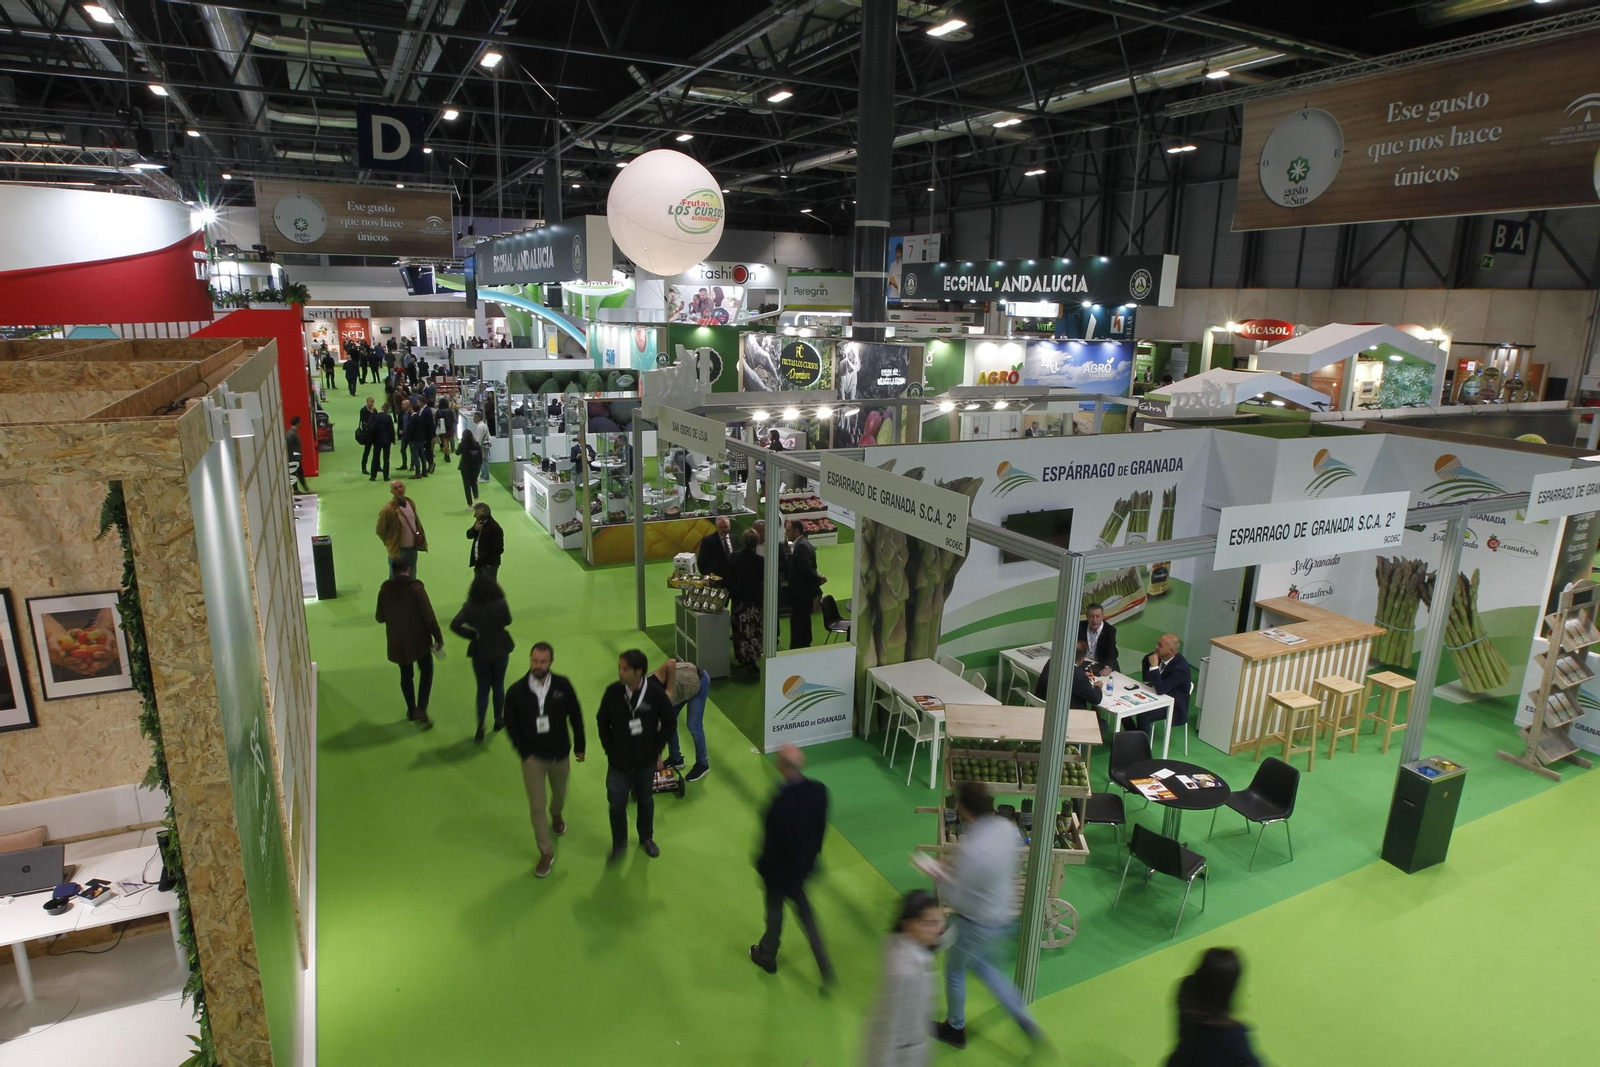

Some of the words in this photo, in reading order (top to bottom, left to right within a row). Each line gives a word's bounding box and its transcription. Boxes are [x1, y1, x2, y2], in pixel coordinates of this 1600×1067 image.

[1387, 101, 1424, 123] Ese
[1426, 90, 1490, 123] gusto
[371, 114, 411, 161] D
[1367, 140, 1404, 163] que
[1408, 134, 1445, 152] nos
[1448, 125, 1503, 147] hace
[1393, 164, 1460, 187] únicos
[1283, 186, 1309, 200] gusto
[347, 200, 366, 213] Ese
[367, 201, 395, 214] gusto
[668, 205, 691, 215] LOS
[681, 198, 710, 208] Frutas
[340, 218, 360, 229] que
[361, 218, 379, 228] nos
[380, 217, 404, 229] hace
[357, 231, 389, 243] únicos
[1494, 224, 1507, 248] B
[1510, 226, 1524, 250] A
[516, 245, 555, 272] ANDALUCIA
[943, 275, 993, 292] ECOHAL
[1000, 273, 1089, 293] ANDALUCIA
[308, 307, 363, 319] serifruit
[976, 369, 1020, 385] AGRO
[1083, 363, 1112, 374] AGRO
[672, 421, 680, 433] SAN
[680, 424, 691, 437] ISIDRO
[692, 427, 698, 439] DE
[1042, 460, 1115, 482] ESPÁRRAGO
[1118, 465, 1129, 476] DE
[1130, 457, 1184, 476] GRANADA
[827, 470, 865, 496] ESPARRAGO
[867, 485, 877, 501] DE
[880, 489, 916, 516] GRANADA
[919, 503, 943, 526] S.C.A.
[1537, 486, 1575, 504] ESPARRAGO
[1575, 484, 1585, 498] DE
[1229, 523, 1290, 546] ESPARRAGO
[1293, 521, 1308, 538] DE
[1311, 516, 1355, 537] GRANADA
[1357, 513, 1382, 531] S.C.A.
[944, 537, 963, 551] 9C06C
[1497, 540, 1539, 557] Granafresh
[1291, 553, 1341, 576] SolGranada
[1296, 586, 1334, 601] Granafresh
[816, 714, 847, 725] GRANADA
